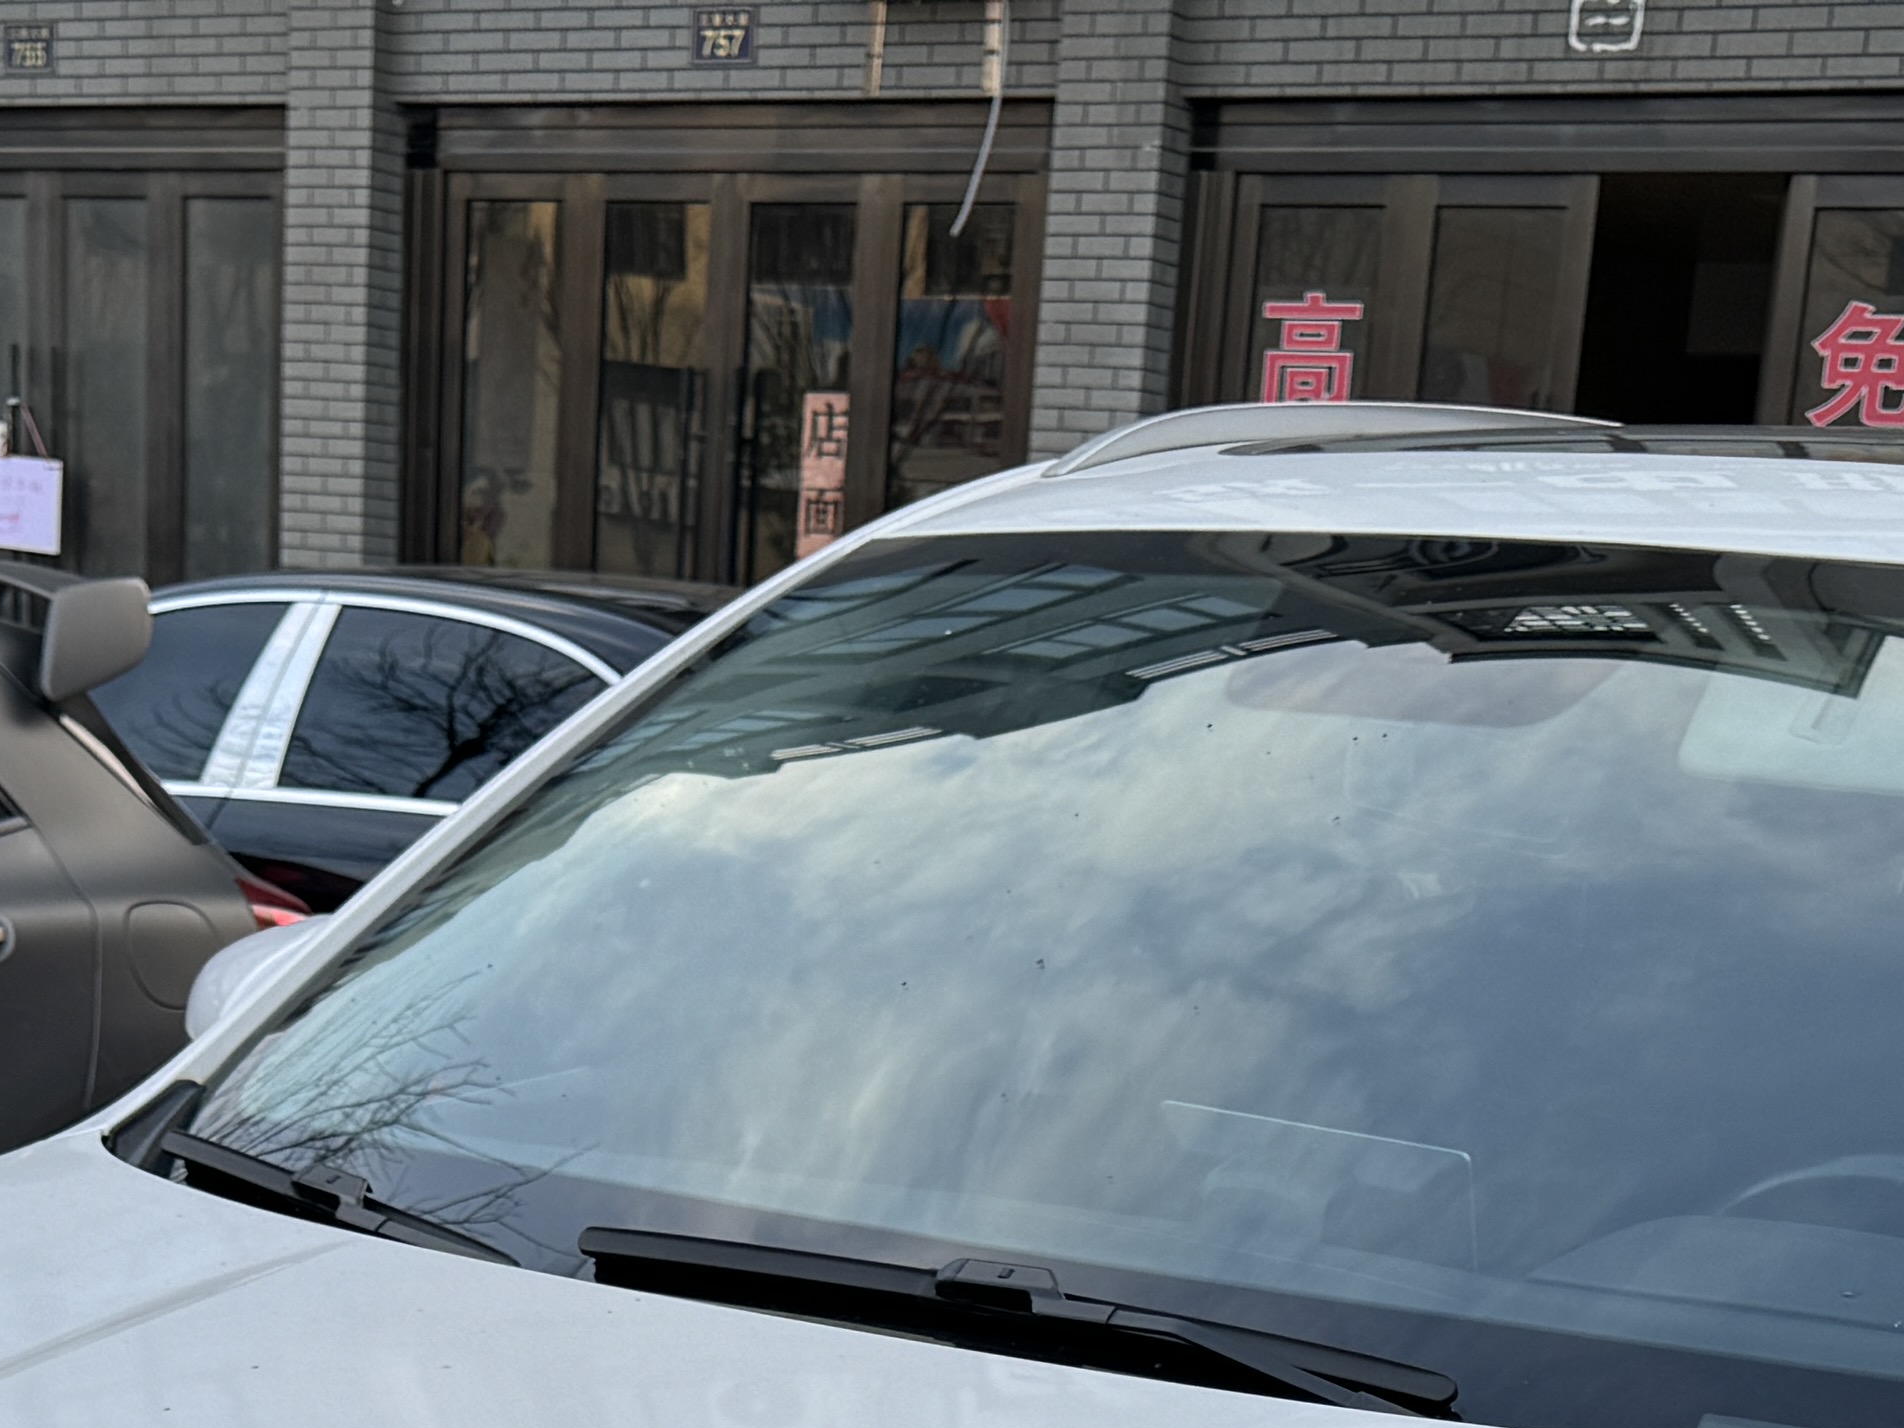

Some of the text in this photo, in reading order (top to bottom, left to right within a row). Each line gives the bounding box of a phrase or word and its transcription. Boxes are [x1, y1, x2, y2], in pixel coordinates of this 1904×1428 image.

[700, 30, 745, 57] 757
[1261, 291, 1365, 405] 高
[804, 400, 848, 538] 店面
